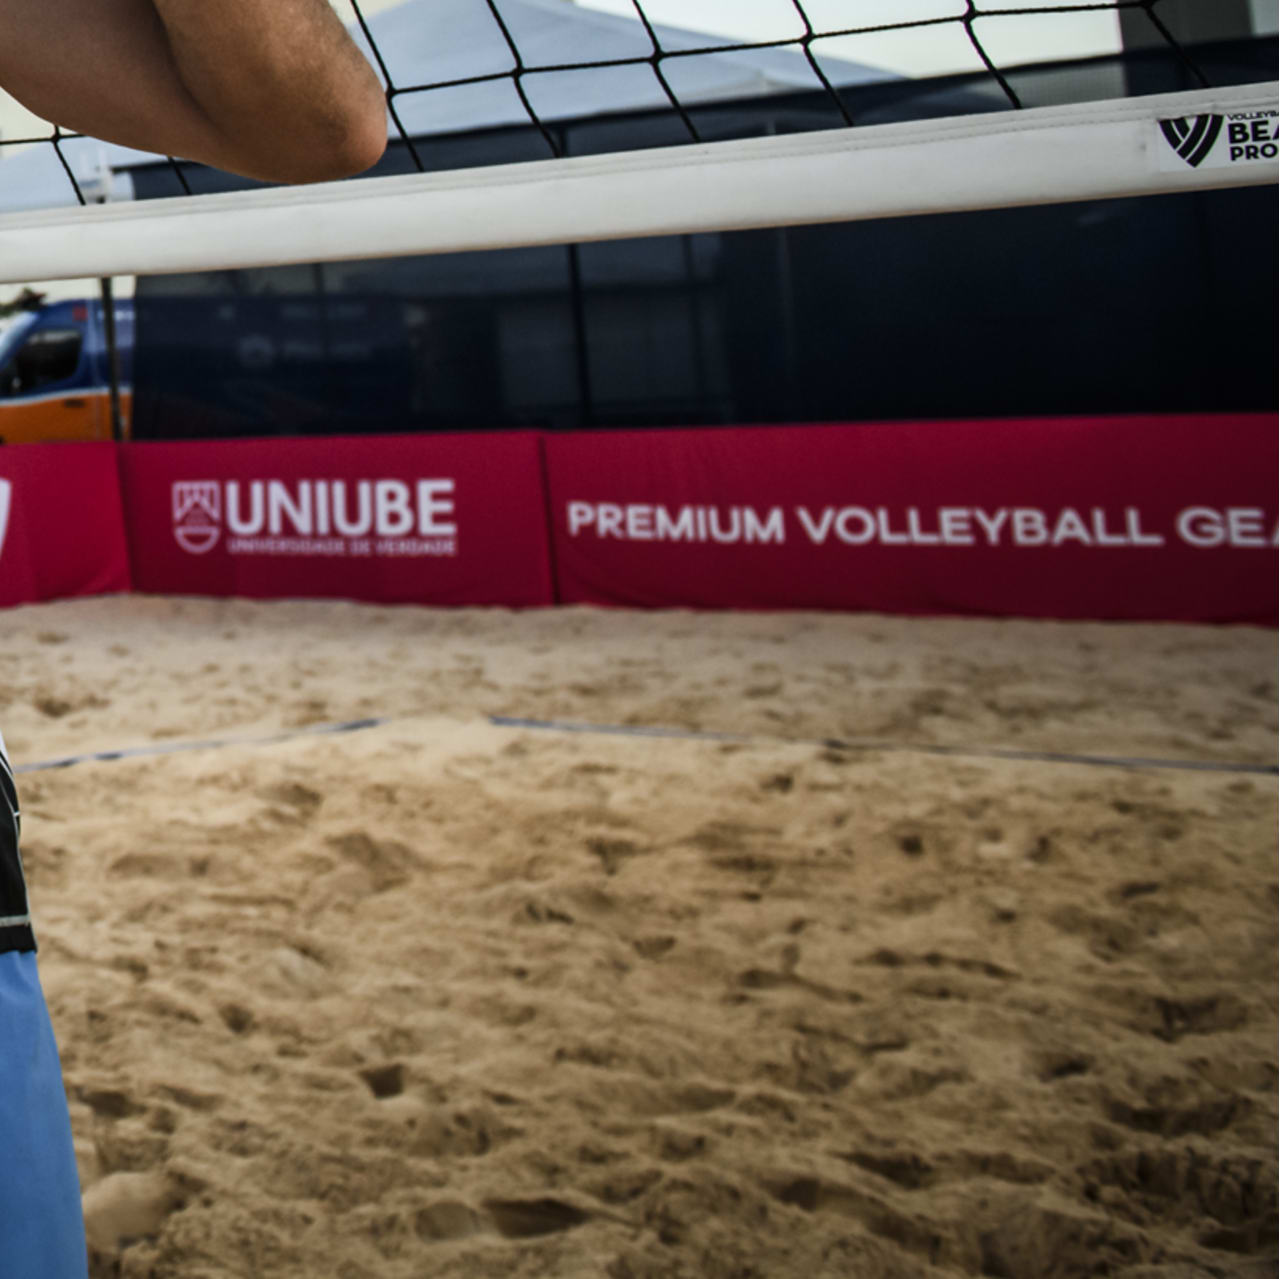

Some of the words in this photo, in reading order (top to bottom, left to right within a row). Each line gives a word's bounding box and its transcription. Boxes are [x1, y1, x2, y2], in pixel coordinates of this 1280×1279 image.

[1230, 143, 1279, 161] PRO
[226, 479, 457, 537] UNIUBE
[567, 501, 786, 545] PREMIUM
[796, 506, 1165, 547] VOLLEYBALL
